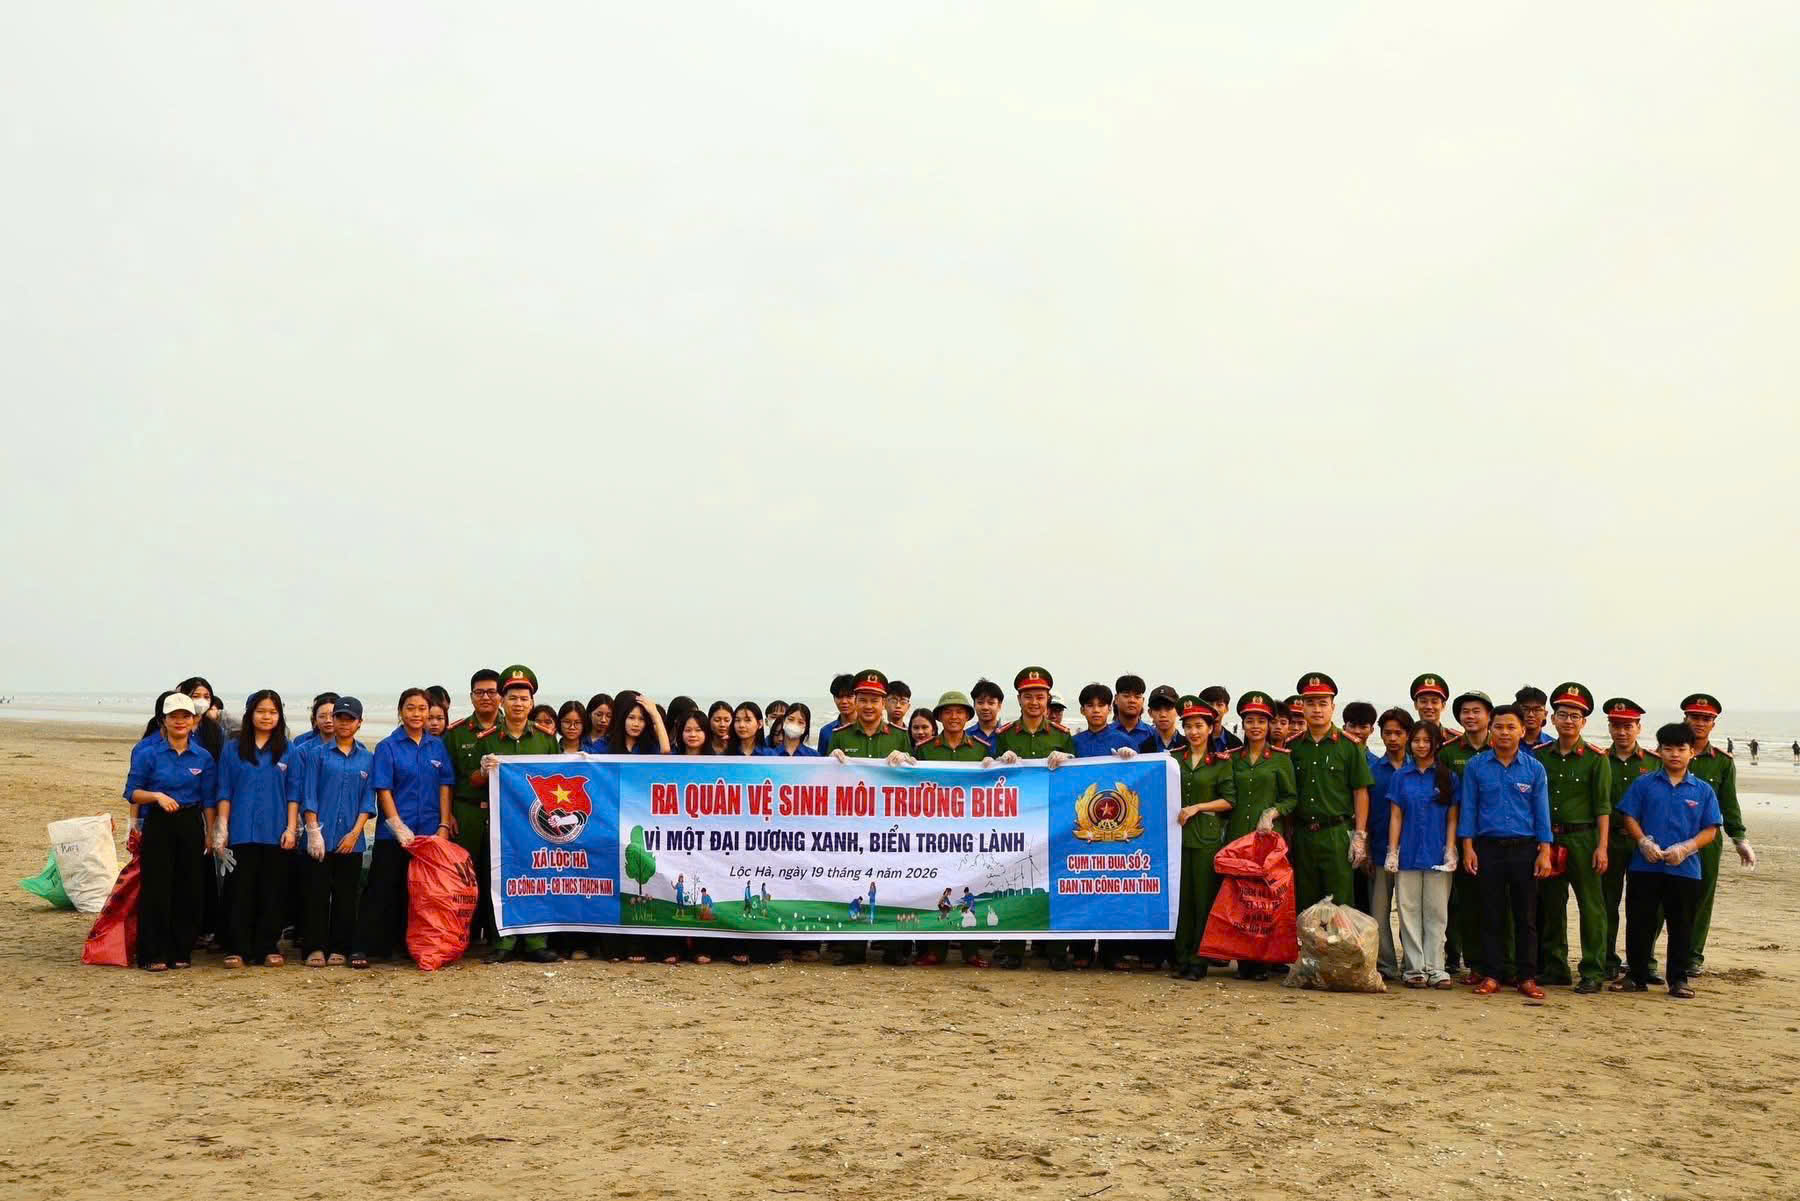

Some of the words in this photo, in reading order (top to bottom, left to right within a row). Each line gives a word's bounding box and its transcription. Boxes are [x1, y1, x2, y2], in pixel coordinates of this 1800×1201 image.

[651, 783, 679, 816] RA
[684, 779, 744, 818] QUÂN
[747, 780, 773, 823] VỆ
[779, 783, 829, 816] SINH
[835, 780, 876, 817] MÔI
[882, 781, 965, 818] TRƯỜNG
[971, 776, 1018, 817] BIỂN
[644, 830, 661, 851] VÌ
[666, 827, 705, 855] MỘT
[710, 830, 739, 855] ĐẠI
[746, 830, 805, 852] DƯƠNG
[811, 832, 863, 854] XANH,
[869, 824, 912, 852] BIỂN
[916, 832, 973, 852] TRONG
[980, 829, 1024, 852] LÀNH
[533, 847, 548, 868] XÃ
[551, 848, 571, 870] LỘC
[573, 849, 588, 868] HÀ
[1067, 855, 1089, 873] CỤM
[1091, 855, 1105, 870] THI
[1108, 855, 1126, 869] ĐUA
[1127, 850, 1142, 869] SỐ
[1143, 855, 1150, 869] 2
[730, 865, 752, 881] Lộc
[755, 866, 775, 879] Hà,
[779, 866, 808, 881] ngày
[811, 867, 824, 877] 19
[827, 867, 862, 881] tháng
[864, 868, 873, 879] 4
[876, 868, 902, 879] năm
[905, 867, 938, 879] 2026
[1058, 879, 1079, 894] BAN
[1080, 879, 1093, 893] TN
[1094, 875, 1120, 893] CÔNG
[1122, 878, 1138, 893] AN
[1138, 873, 1160, 893] TỈNH
[518, 876, 535, 895] CÔNG
[536, 879, 546, 895] AN
[561, 878, 578, 895] THCS
[600, 879, 613, 895] KIM
